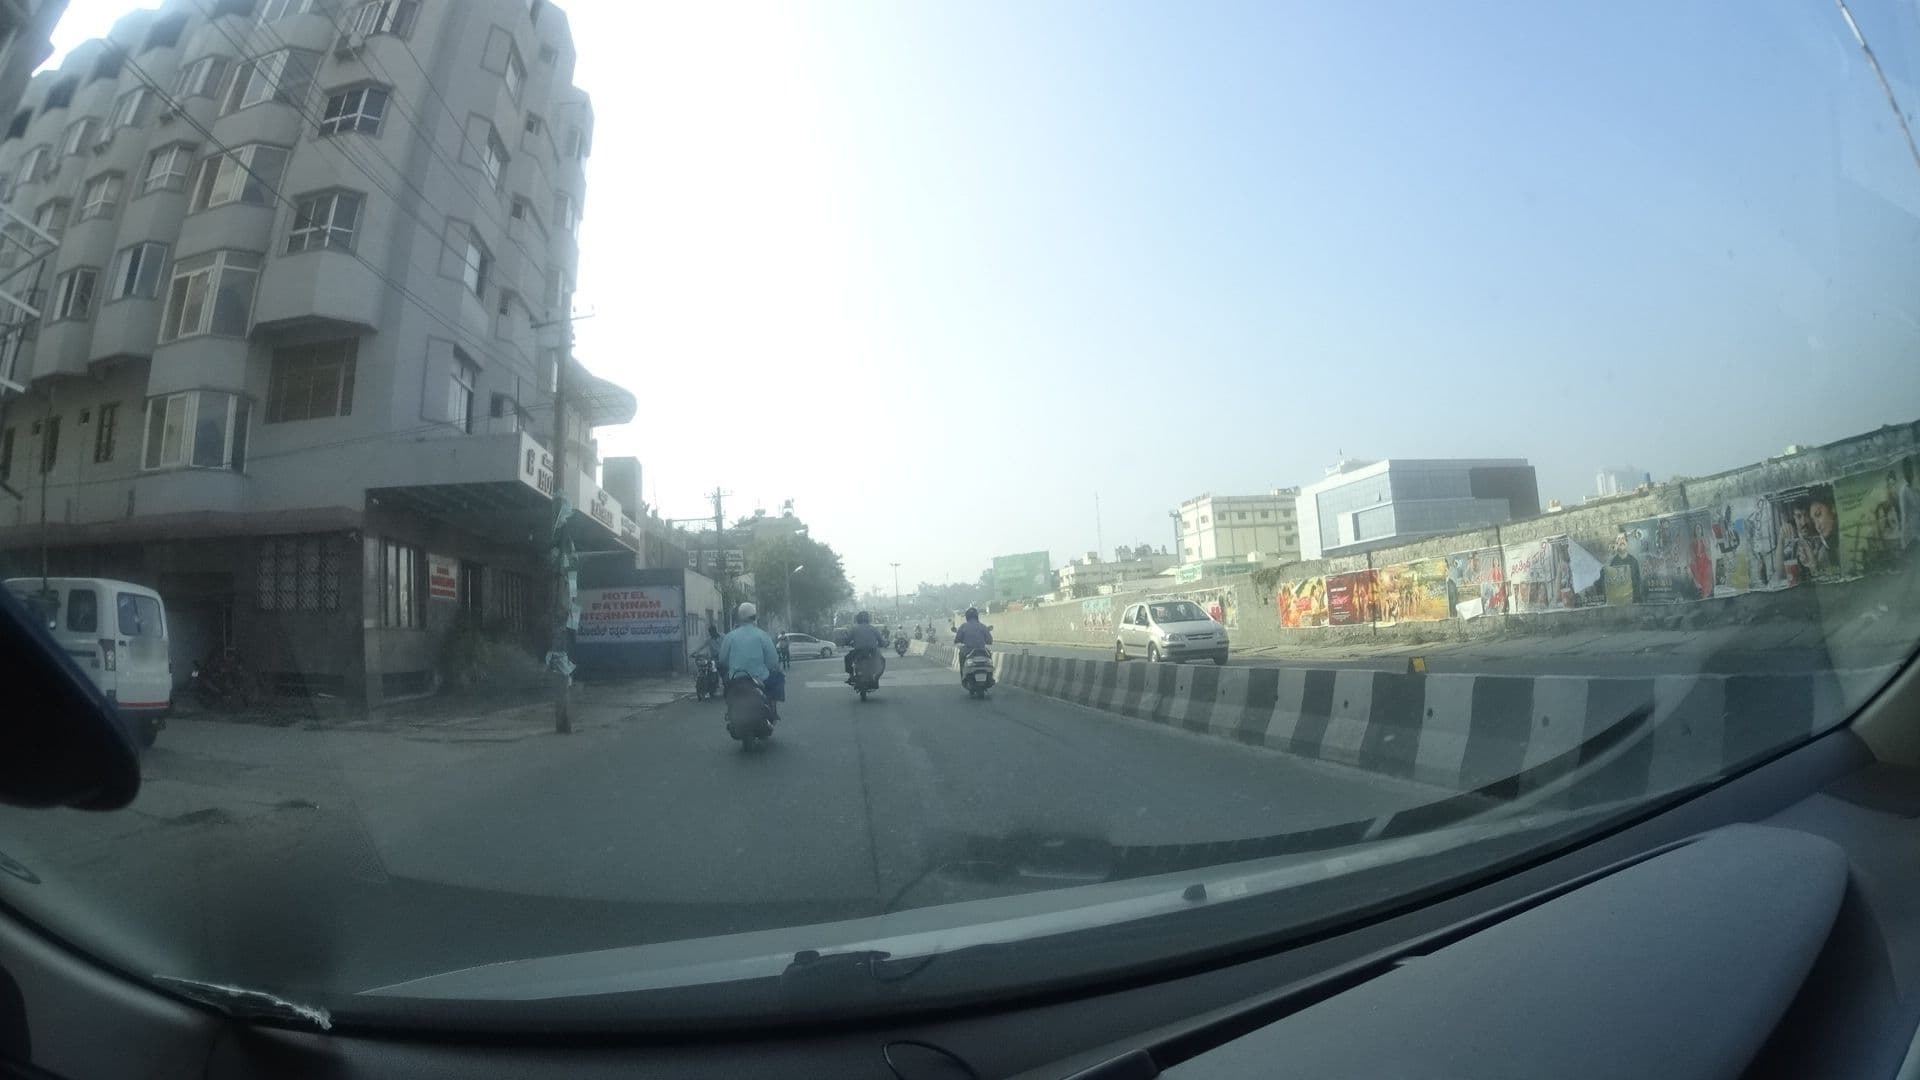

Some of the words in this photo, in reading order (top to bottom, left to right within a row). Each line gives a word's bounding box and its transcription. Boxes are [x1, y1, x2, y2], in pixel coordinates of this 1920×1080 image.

[602, 591, 648, 601] HOTEL
[592, 600, 662, 611] RATHNAM
[580, 609, 680, 621] NTERNATIONAL
